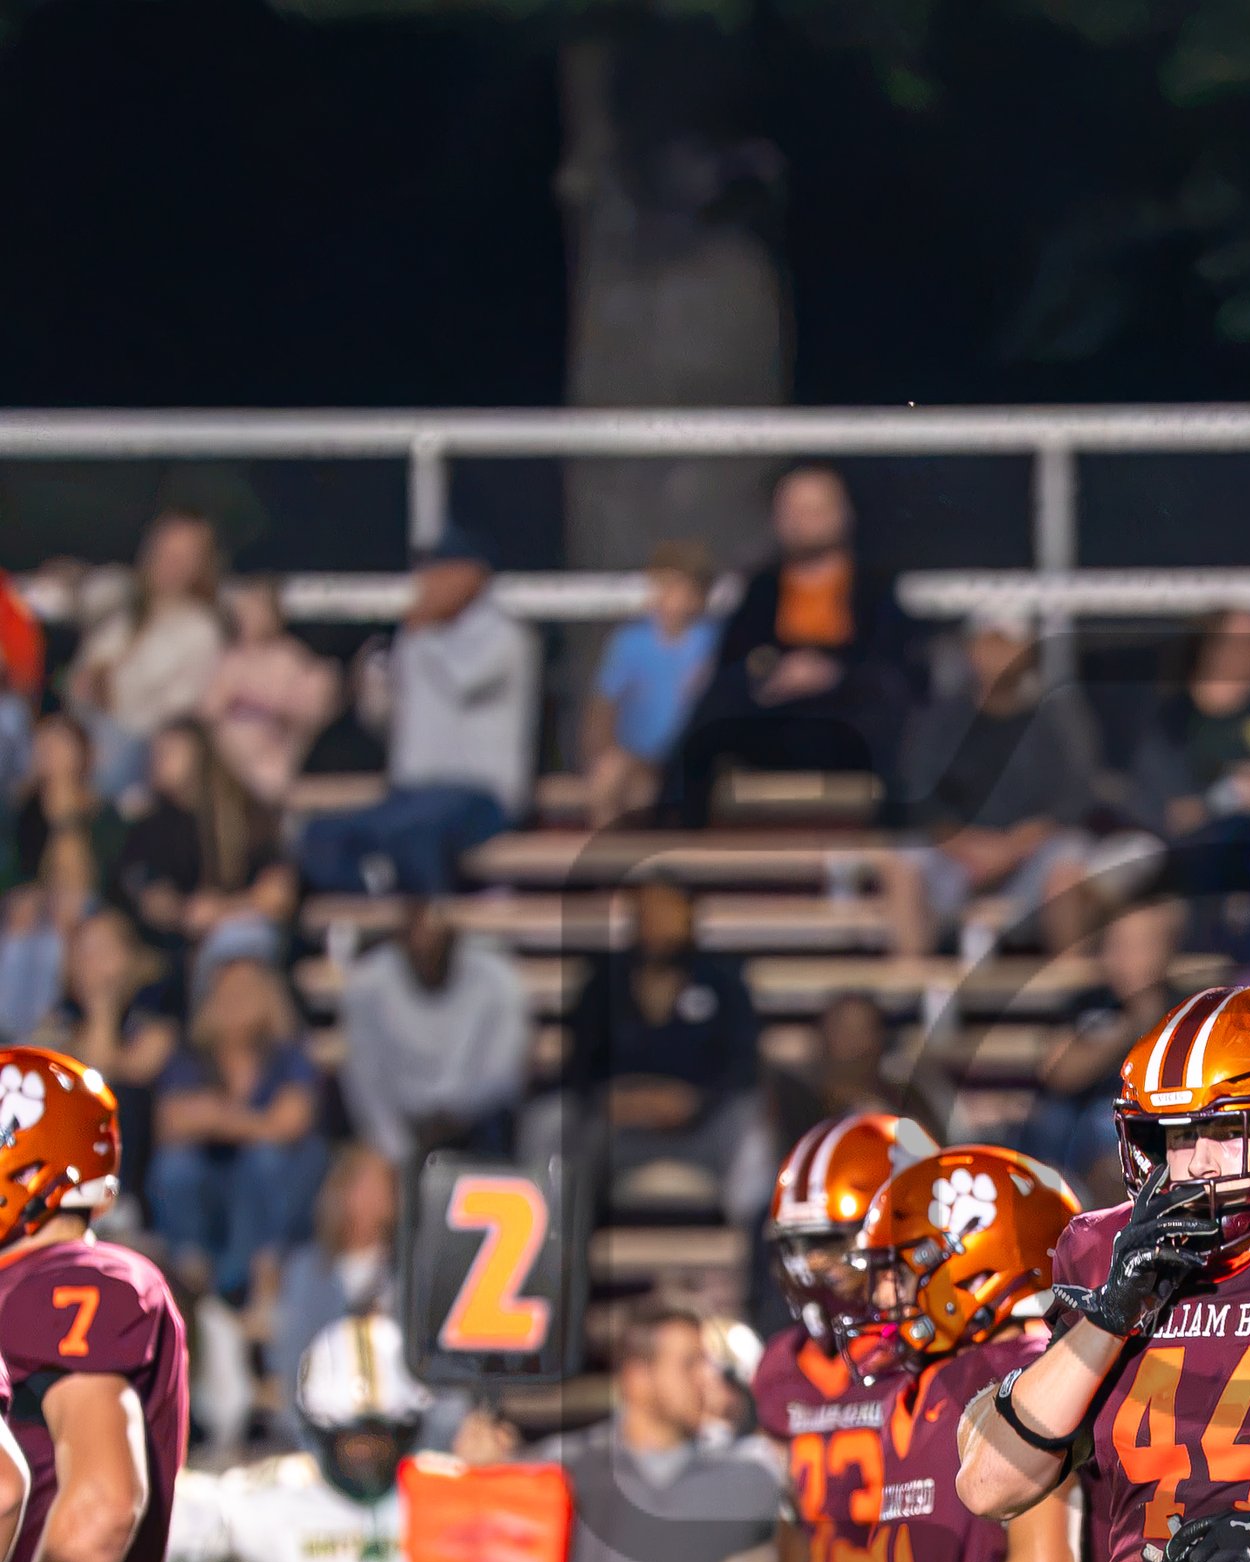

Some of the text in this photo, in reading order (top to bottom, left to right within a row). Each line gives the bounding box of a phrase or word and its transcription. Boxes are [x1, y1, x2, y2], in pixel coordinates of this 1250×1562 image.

[441, 1176, 549, 1352] 2
[53, 1286, 100, 1357] 7
[1153, 1302, 1231, 1338] LIAM
